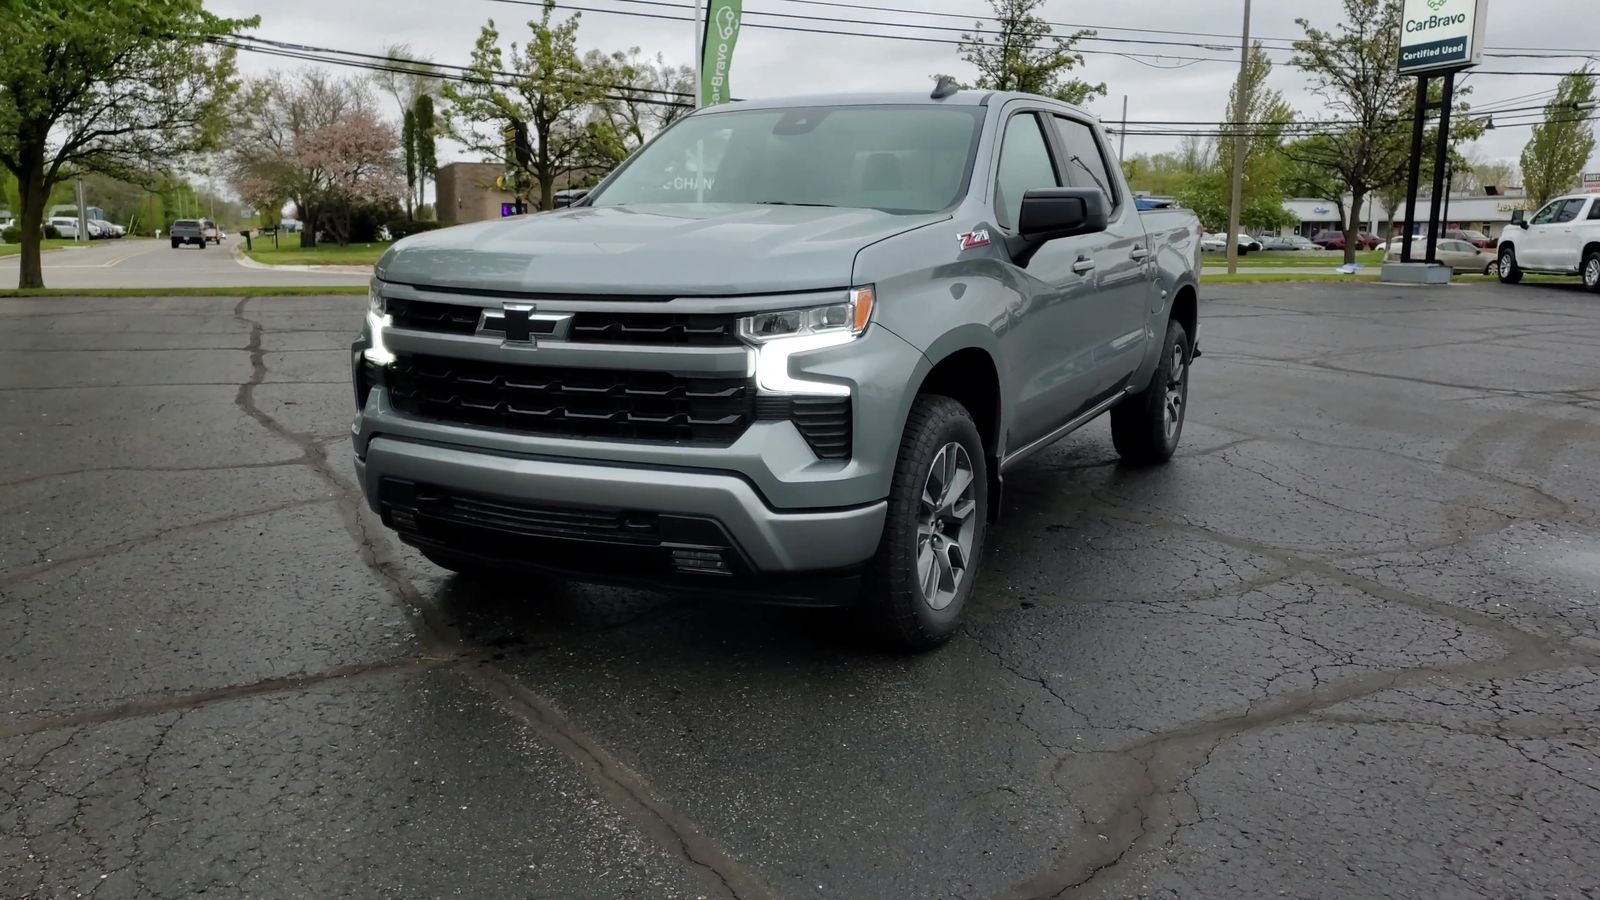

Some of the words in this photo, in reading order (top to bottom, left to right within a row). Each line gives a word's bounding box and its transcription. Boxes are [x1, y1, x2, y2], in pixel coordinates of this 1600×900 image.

[1405, 13, 1466, 33] CarBravo
[1402, 47, 1440, 60] Certified
[1441, 43, 1464, 55] Used
